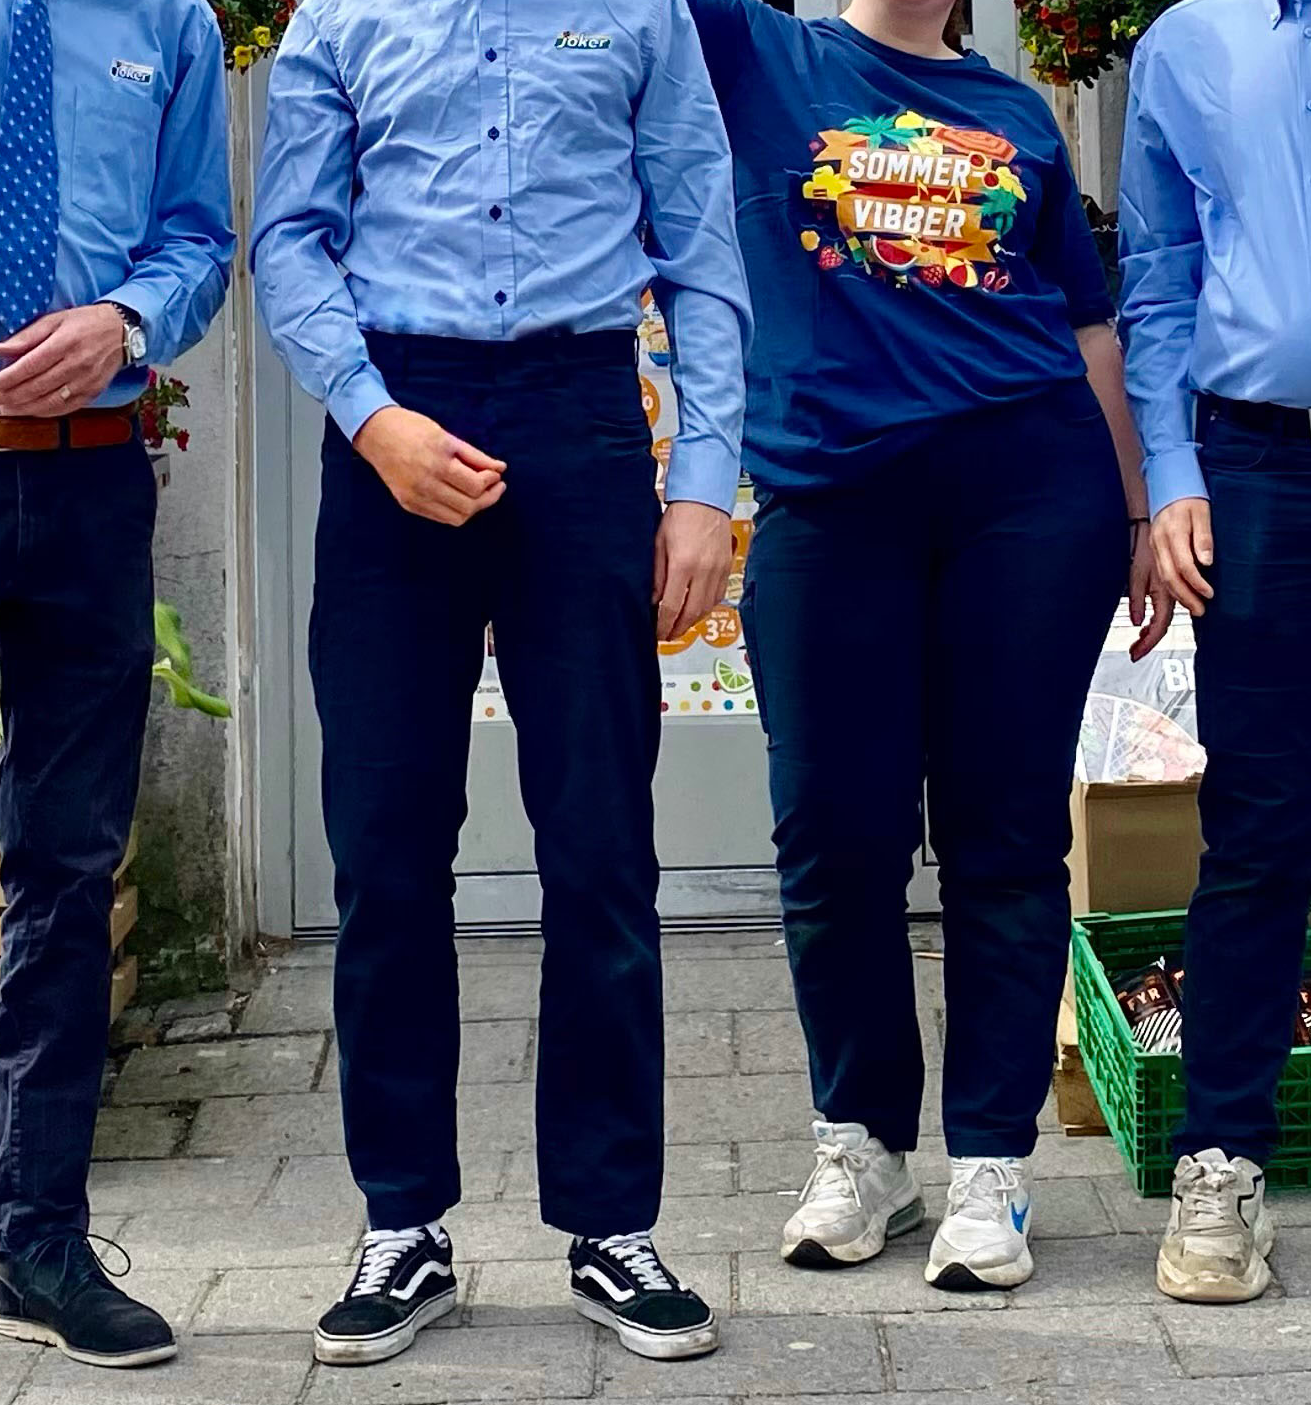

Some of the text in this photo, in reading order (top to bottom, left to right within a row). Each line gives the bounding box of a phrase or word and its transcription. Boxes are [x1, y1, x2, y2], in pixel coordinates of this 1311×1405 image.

[555, 30, 609, 50] joker
[853, 198, 967, 238] VIBBER
[1126, 985, 1161, 1012] FYR
